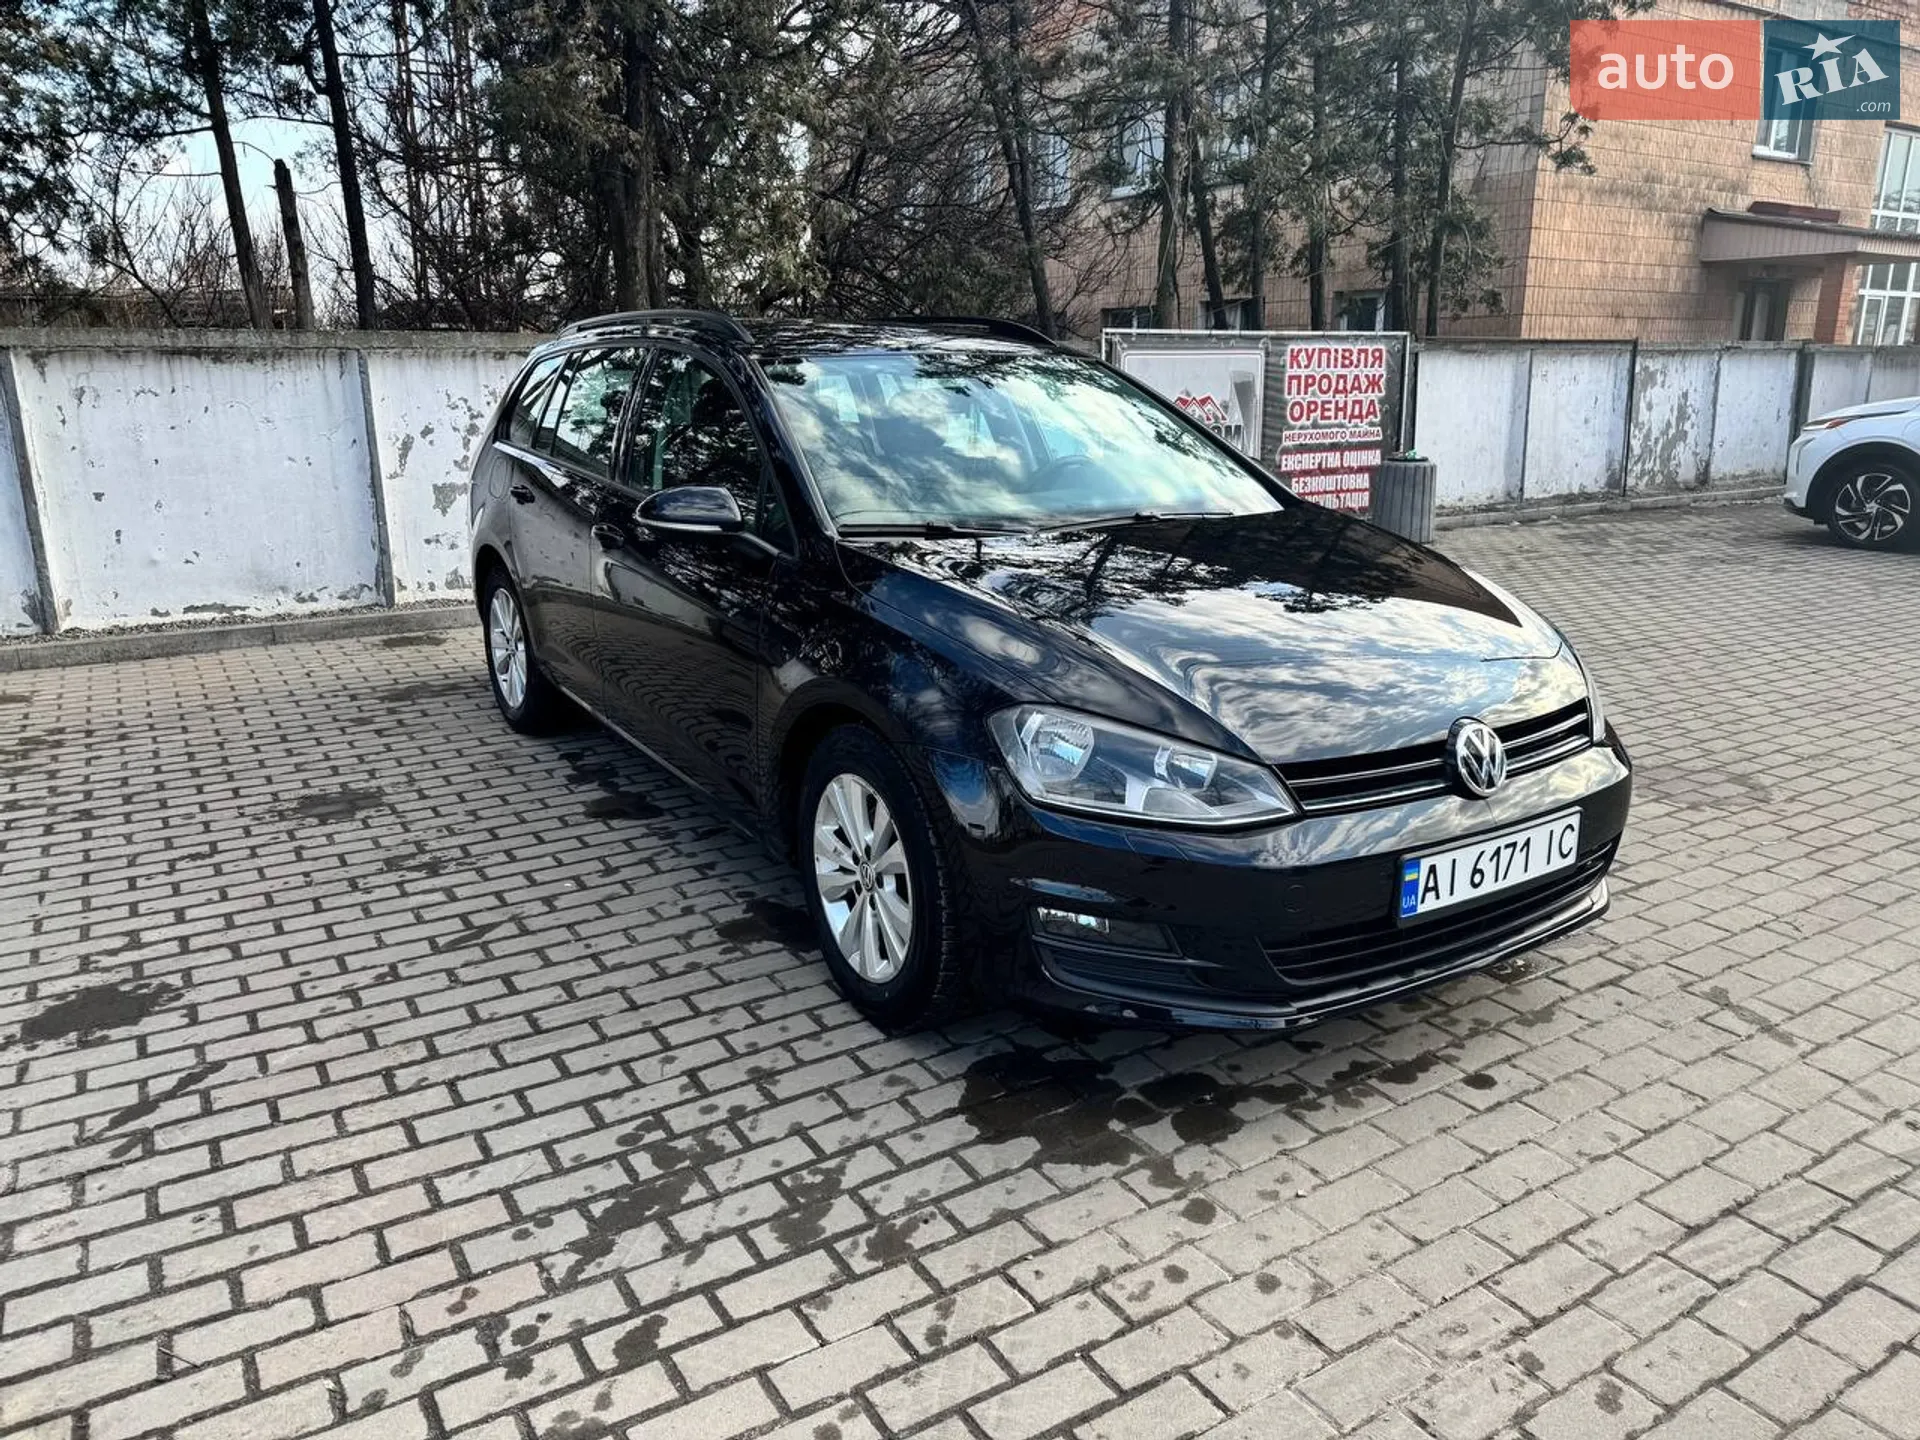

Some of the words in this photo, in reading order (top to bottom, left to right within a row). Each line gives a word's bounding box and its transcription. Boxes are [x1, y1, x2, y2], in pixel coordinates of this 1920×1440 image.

[1288, 347, 1384, 370] КУПІВЛЯ
[1287, 374, 1384, 397] ПРОДАЖ
[1288, 401, 1379, 424] ОРЕНДА
[1284, 431, 1347, 442] НЕРУХОМОГО
[1349, 428, 1381, 439] МАЙНА
[1281, 452, 1340, 471] ЕКСПЕРТНА
[1343, 449, 1381, 468] ОЦІНКА
[1291, 473, 1369, 493] БЕЗКОШТОВНА
[1420, 858, 1456, 904] AI
[1470, 837, 1531, 889] 6171
[1547, 824, 1575, 865] IC
[1402, 896, 1416, 908] UA
